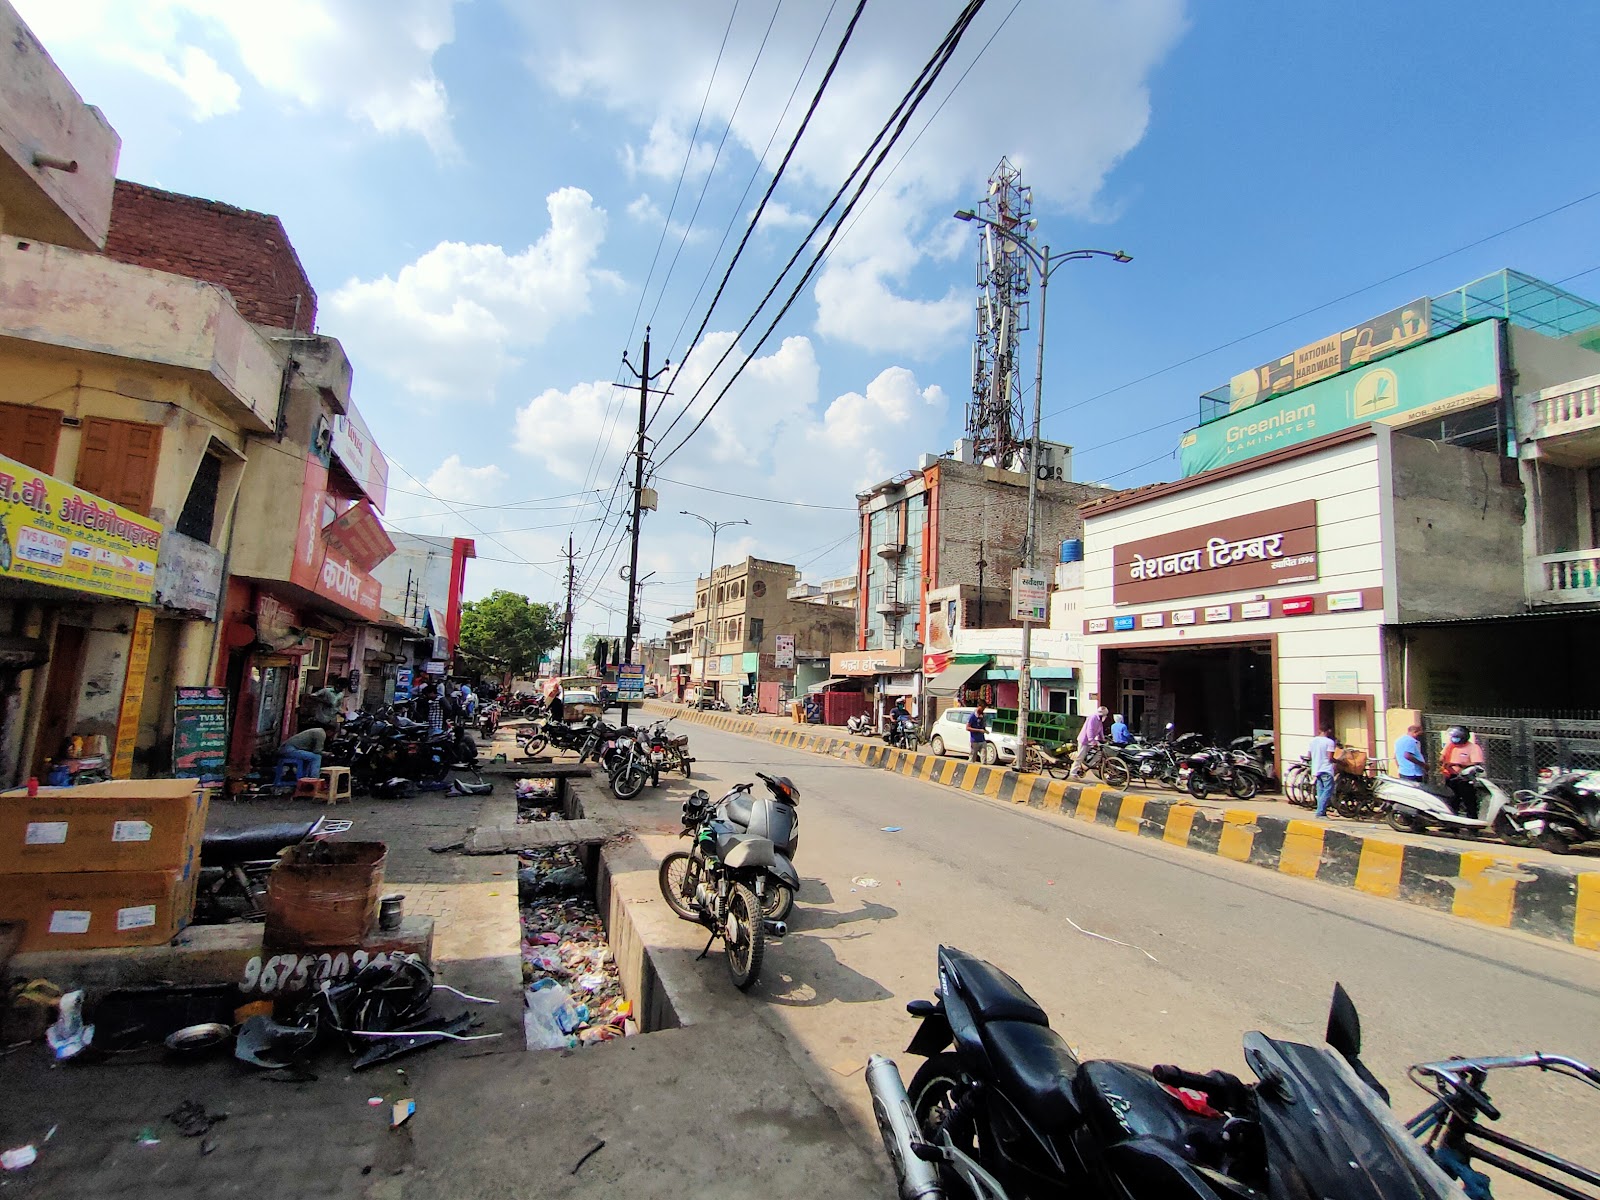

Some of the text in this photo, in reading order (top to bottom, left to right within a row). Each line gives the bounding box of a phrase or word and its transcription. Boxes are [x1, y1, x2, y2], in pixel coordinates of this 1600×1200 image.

[1298, 341, 1337, 364] NATIONAL
[1295, 354, 1339, 380] HARDWARE
[1226, 403, 1316, 443] Greenlam
[1408, 409, 1430, 420] MOB:
[1226, 420, 1316, 454] LAMINATES
[20, 528, 38, 543] TVS
[71, 547, 89, 558] TVS
[1130, 533, 1284, 580] नेशनल टिम्बर
[1298, 555, 1314, 566] 1996
